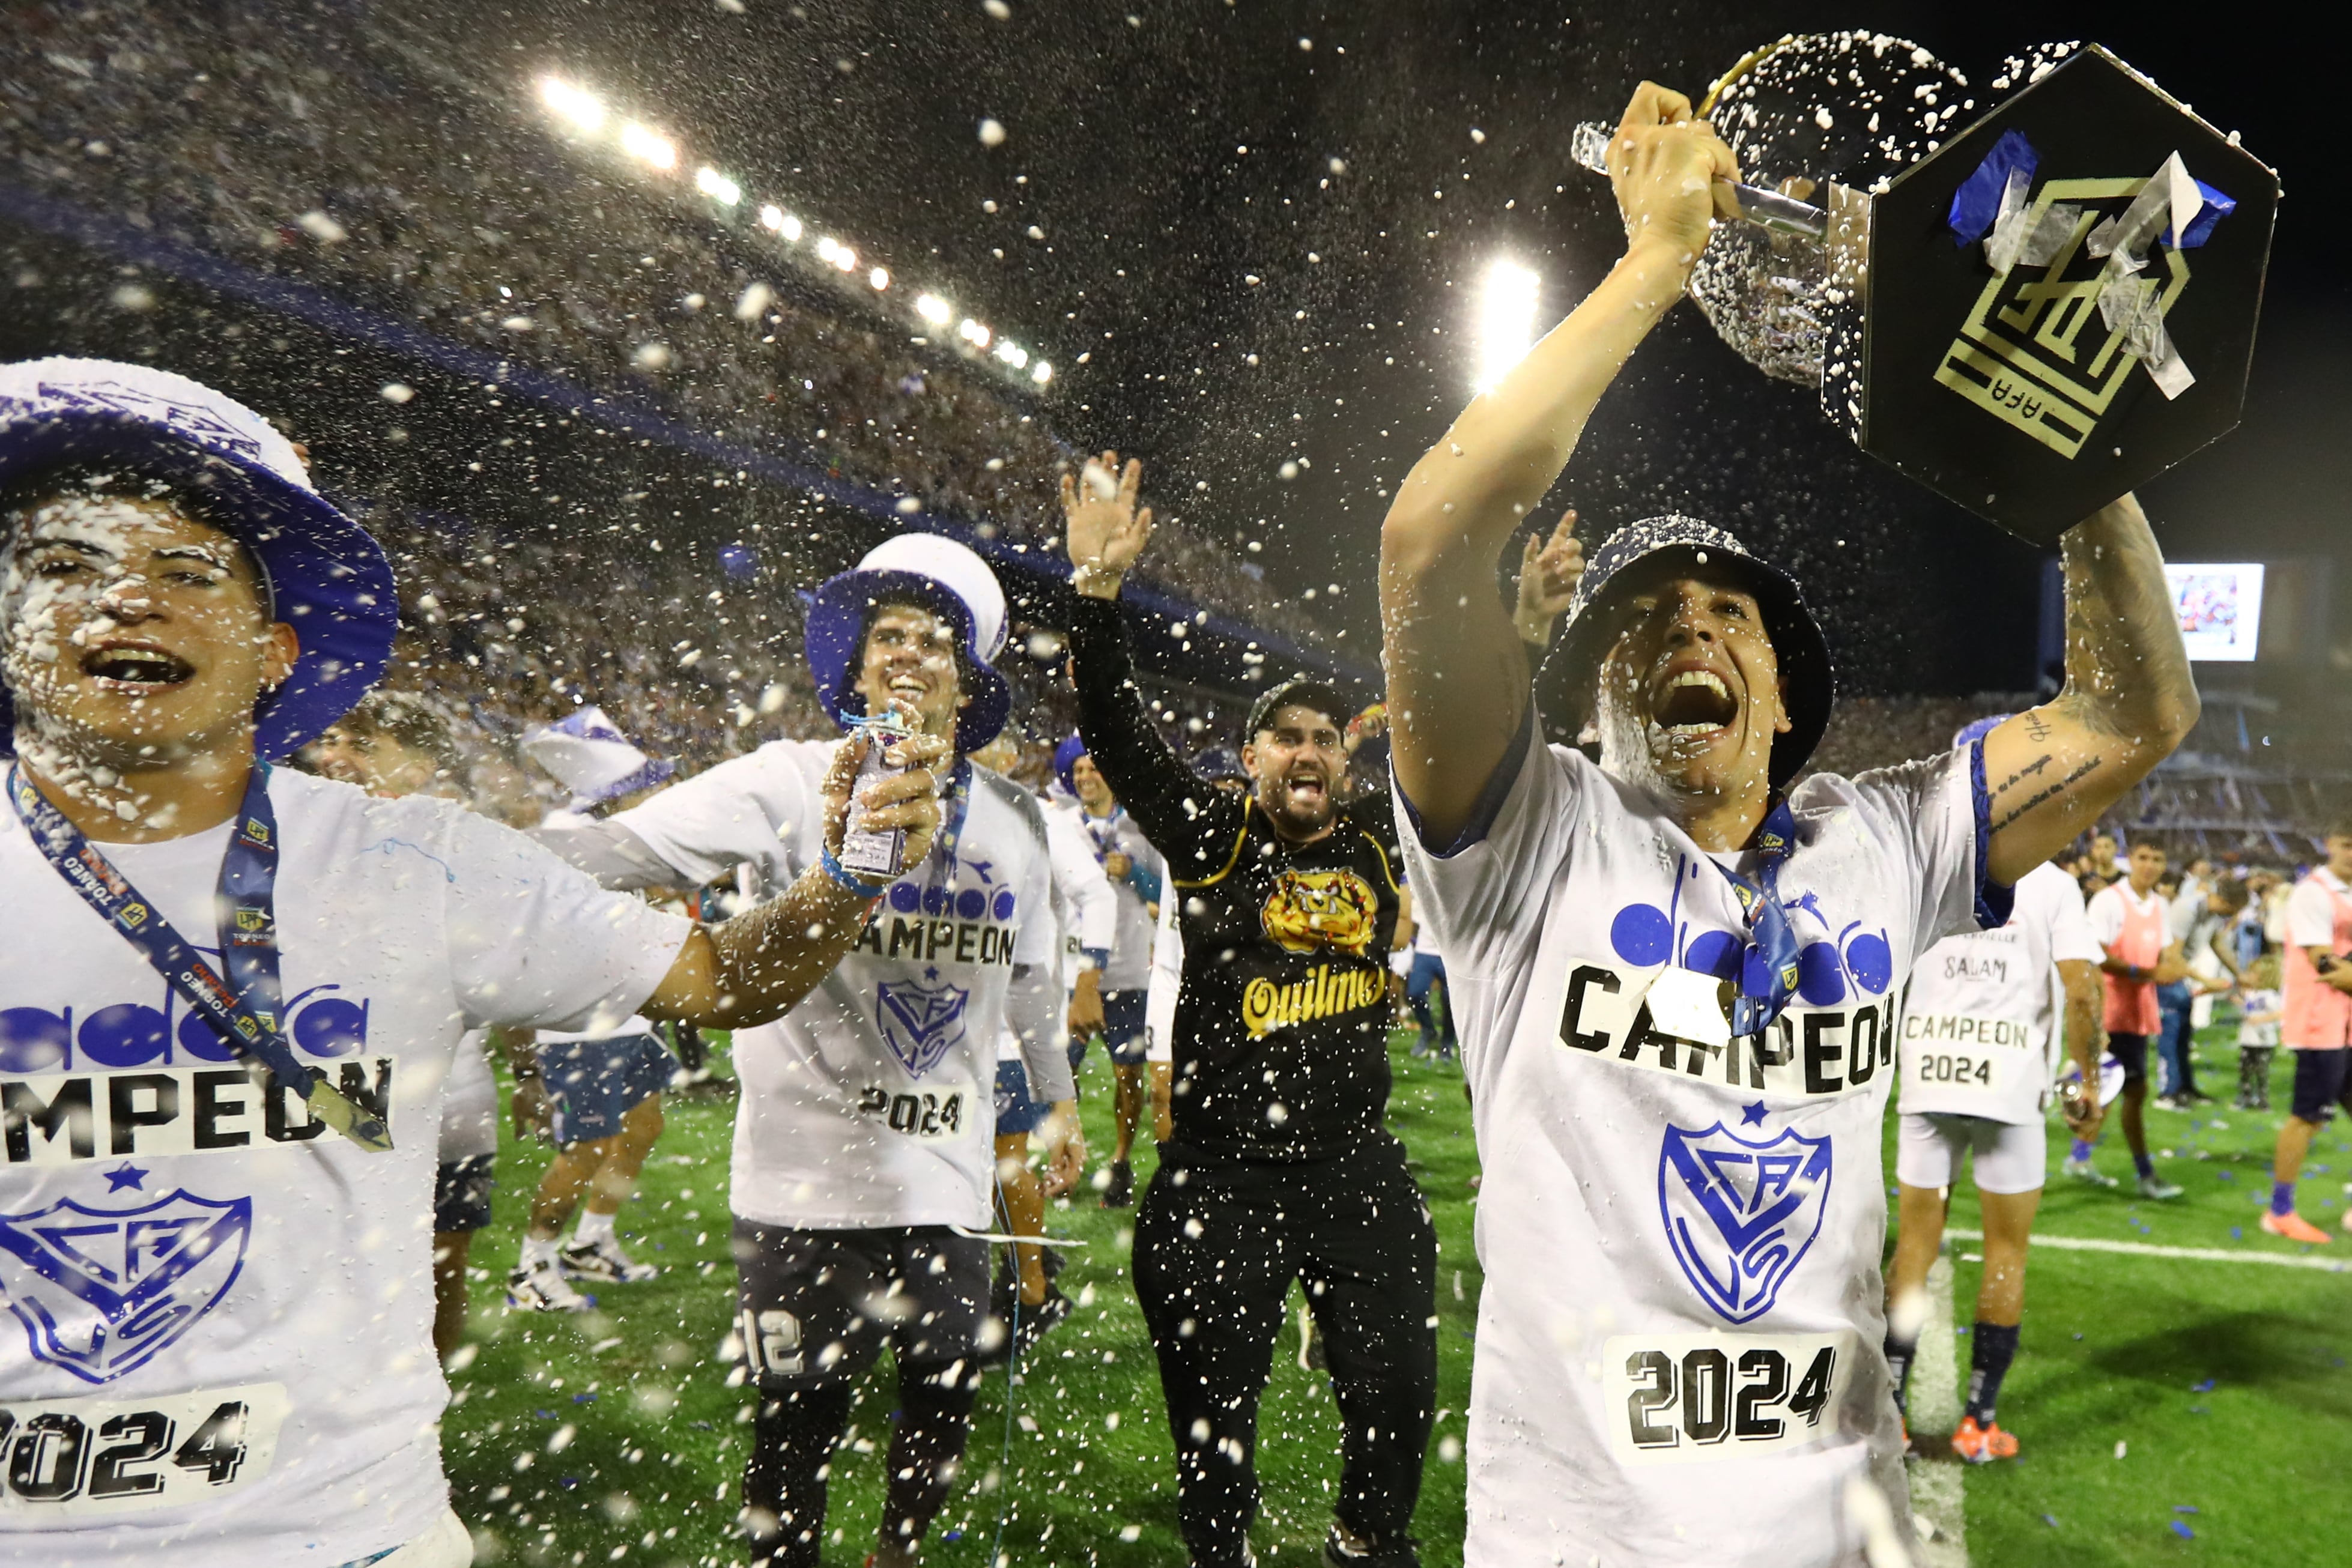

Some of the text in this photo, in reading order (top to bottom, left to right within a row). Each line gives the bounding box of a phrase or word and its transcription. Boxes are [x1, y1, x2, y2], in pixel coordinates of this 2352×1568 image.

[1992, 379, 2041, 419] AFA
[64, 857, 114, 906] TORNEO
[852, 913, 1016, 966] AMPEON
[181, 971, 229, 1017] TORNEO
[1906, 1016, 2028, 1049] CAMPEON
[1921, 1055, 1990, 1085] 2024
[2, 1058, 392, 1163] MPEON
[860, 1086, 963, 1137] 2024
[742, 1307, 803, 1375] 12
[1626, 1346, 1836, 1449] 2024
[0, 1401, 249, 1502] 024
